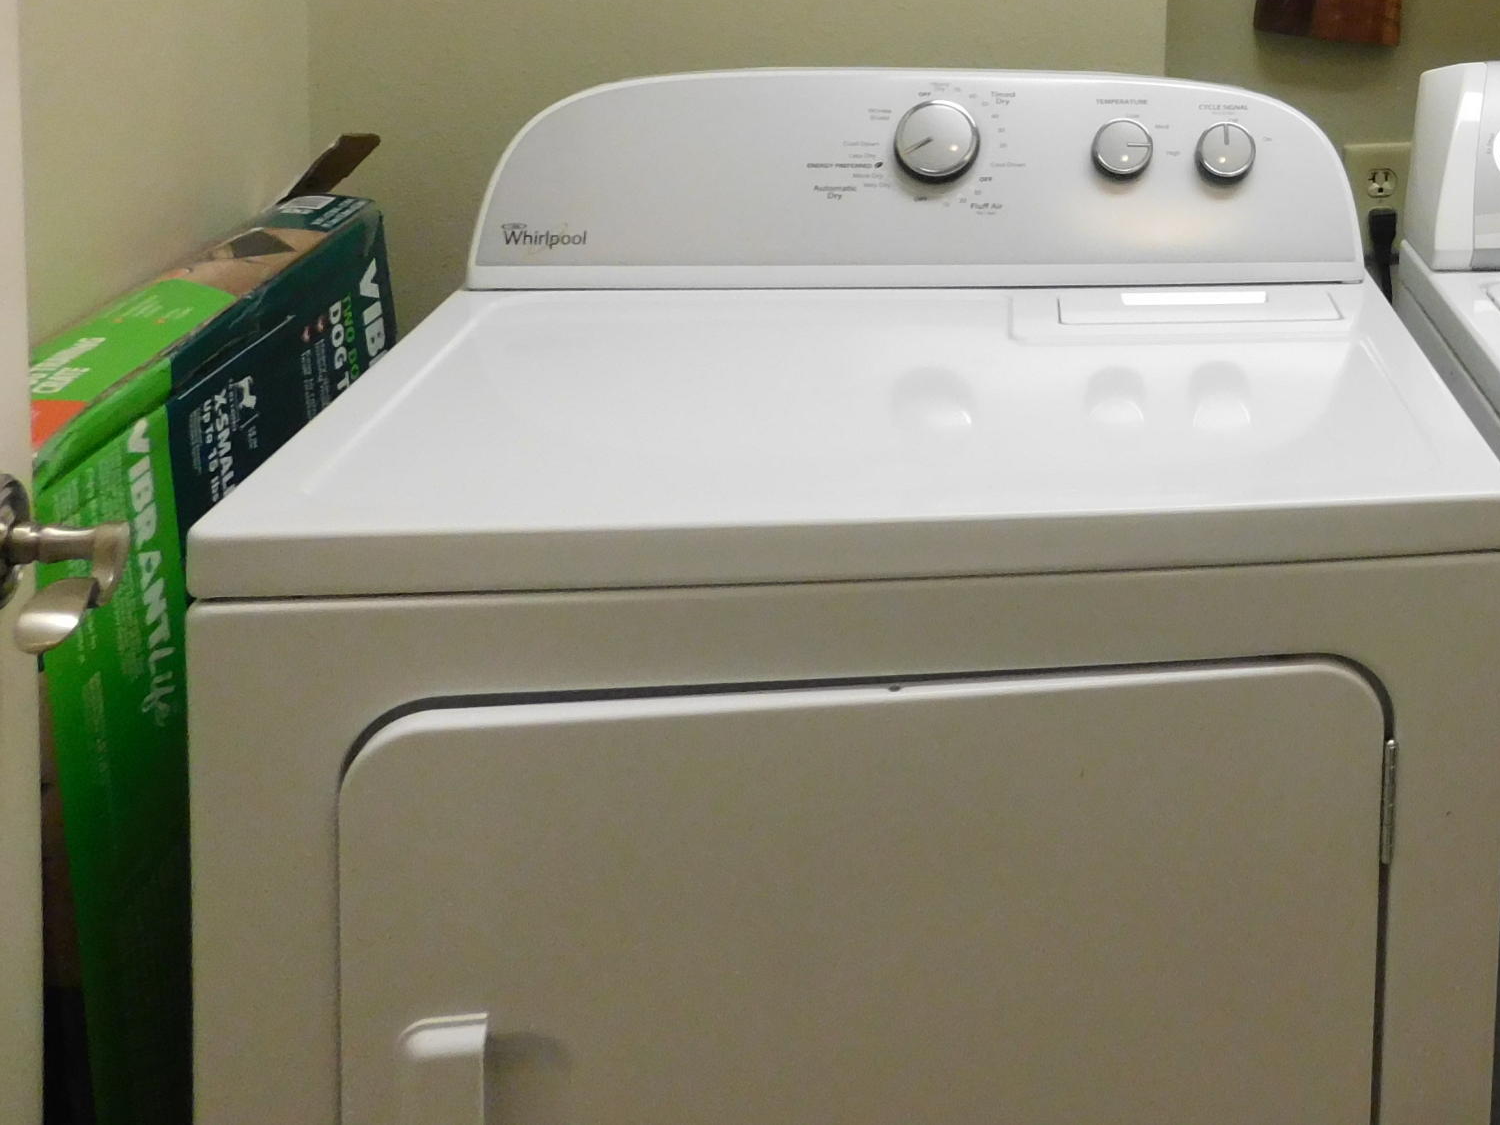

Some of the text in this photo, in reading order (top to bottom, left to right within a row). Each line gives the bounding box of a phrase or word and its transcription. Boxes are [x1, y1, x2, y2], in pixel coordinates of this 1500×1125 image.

[1096, 98, 1148, 106] TEMPERATURE
[826, 192, 842, 200] Dry
[503, 230, 587, 250] Whirlpool
[342, 293, 356, 344] TWO
[329, 300, 347, 370] DOG
